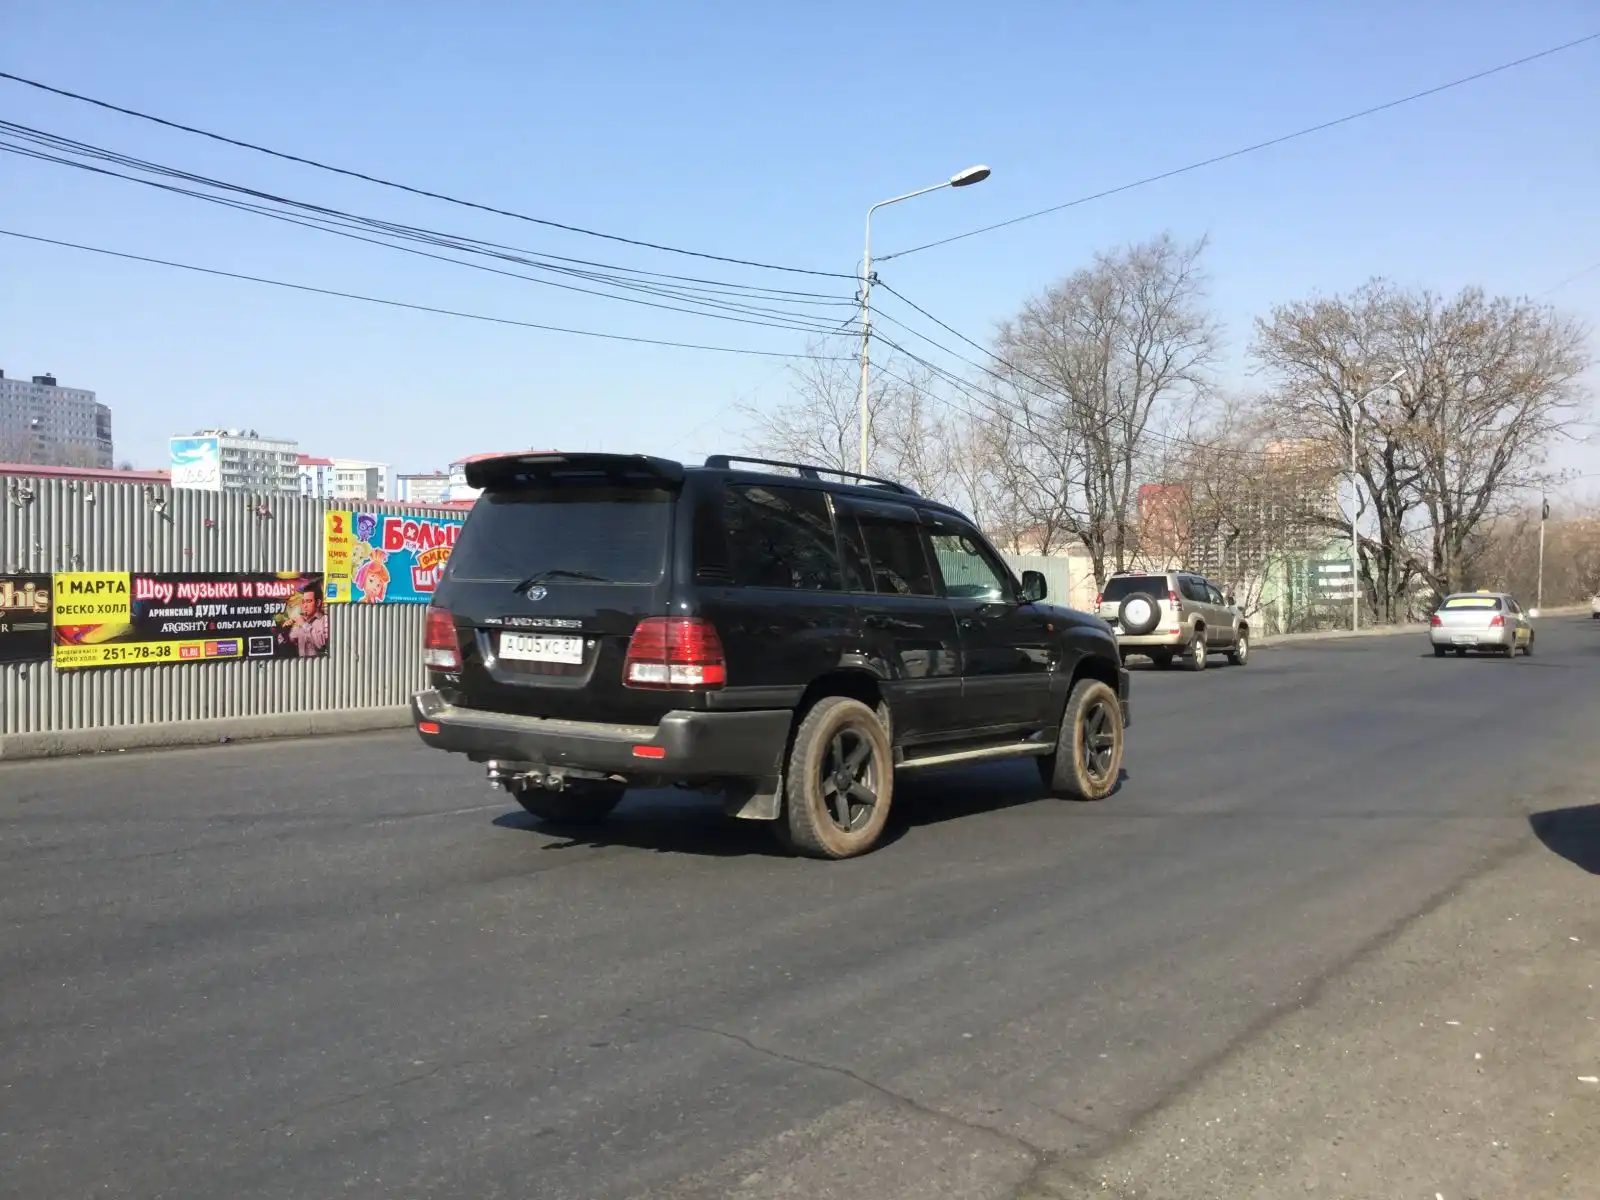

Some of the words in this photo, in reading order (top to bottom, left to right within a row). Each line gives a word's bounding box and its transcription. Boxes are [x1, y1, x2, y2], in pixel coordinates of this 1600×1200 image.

[332, 515, 343, 533] 2
[56, 582, 64, 593] 1
[71, 581, 126, 593] МАРТА
[136, 578, 173, 604] Шоу
[56, 605, 95, 614] ФЕСКО
[98, 604, 127, 613] ХОЛЛ
[195, 604, 228, 618] ДУДУК
[264, 603, 286, 613] ЭБРУ
[161, 621, 208, 633] ARGISHTY
[216, 621, 241, 630] ОЛЬГА
[243, 620, 277, 629] КАУРОВА
[103, 646, 171, 661] 251-78-38
